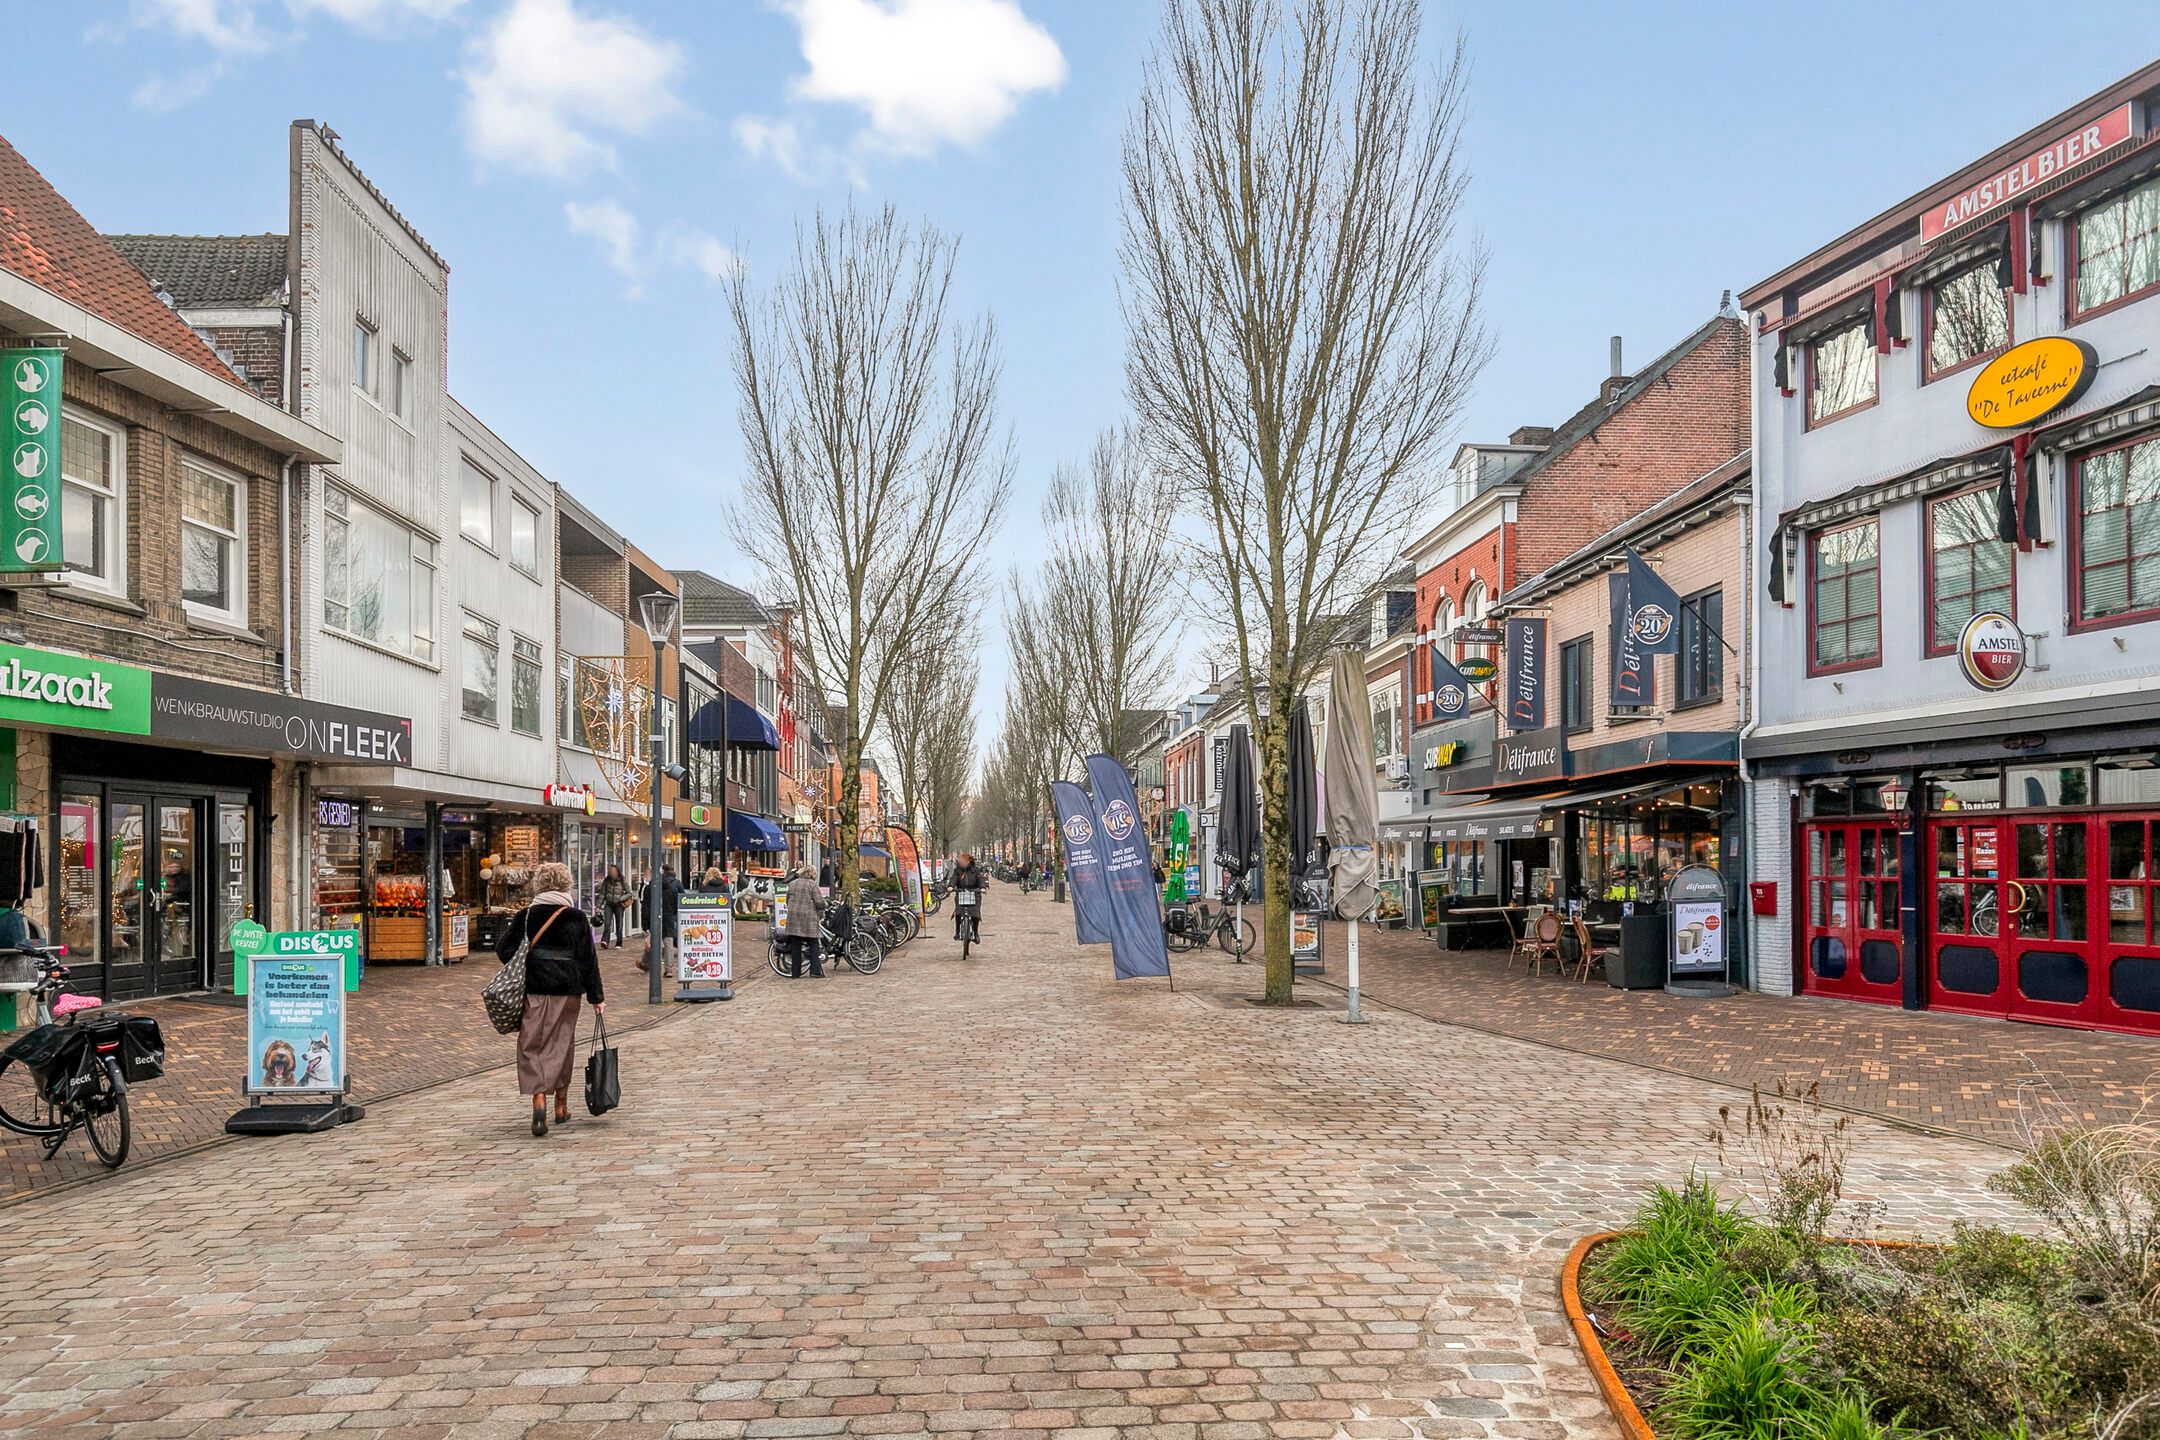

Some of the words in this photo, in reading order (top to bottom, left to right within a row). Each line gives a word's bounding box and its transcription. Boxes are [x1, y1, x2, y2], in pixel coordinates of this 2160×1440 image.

[1943, 162, 2036, 229] AMSTEL
[2037, 125, 2102, 180] BIER
[2000, 353, 2048, 385] eetcafé
[1640, 618, 1661, 634] 20
[1978, 637, 2020, 650] AMSTEL
[1991, 654, 2012, 664] BIER
[1514, 625, 1538, 722] Délifrance
[1442, 695, 1457, 705] 20
[155, 696, 284, 729] WENKBRAUWSTUDIO
[1423, 740, 1457, 770] SUBWAY
[1497, 742, 1557, 776] Délifrance
[1680, 905, 1717, 915] Délifrance
[280, 933, 354, 953] DISCUS
[265, 991, 329, 999] behandelen
[309, 982, 330, 990] dan
